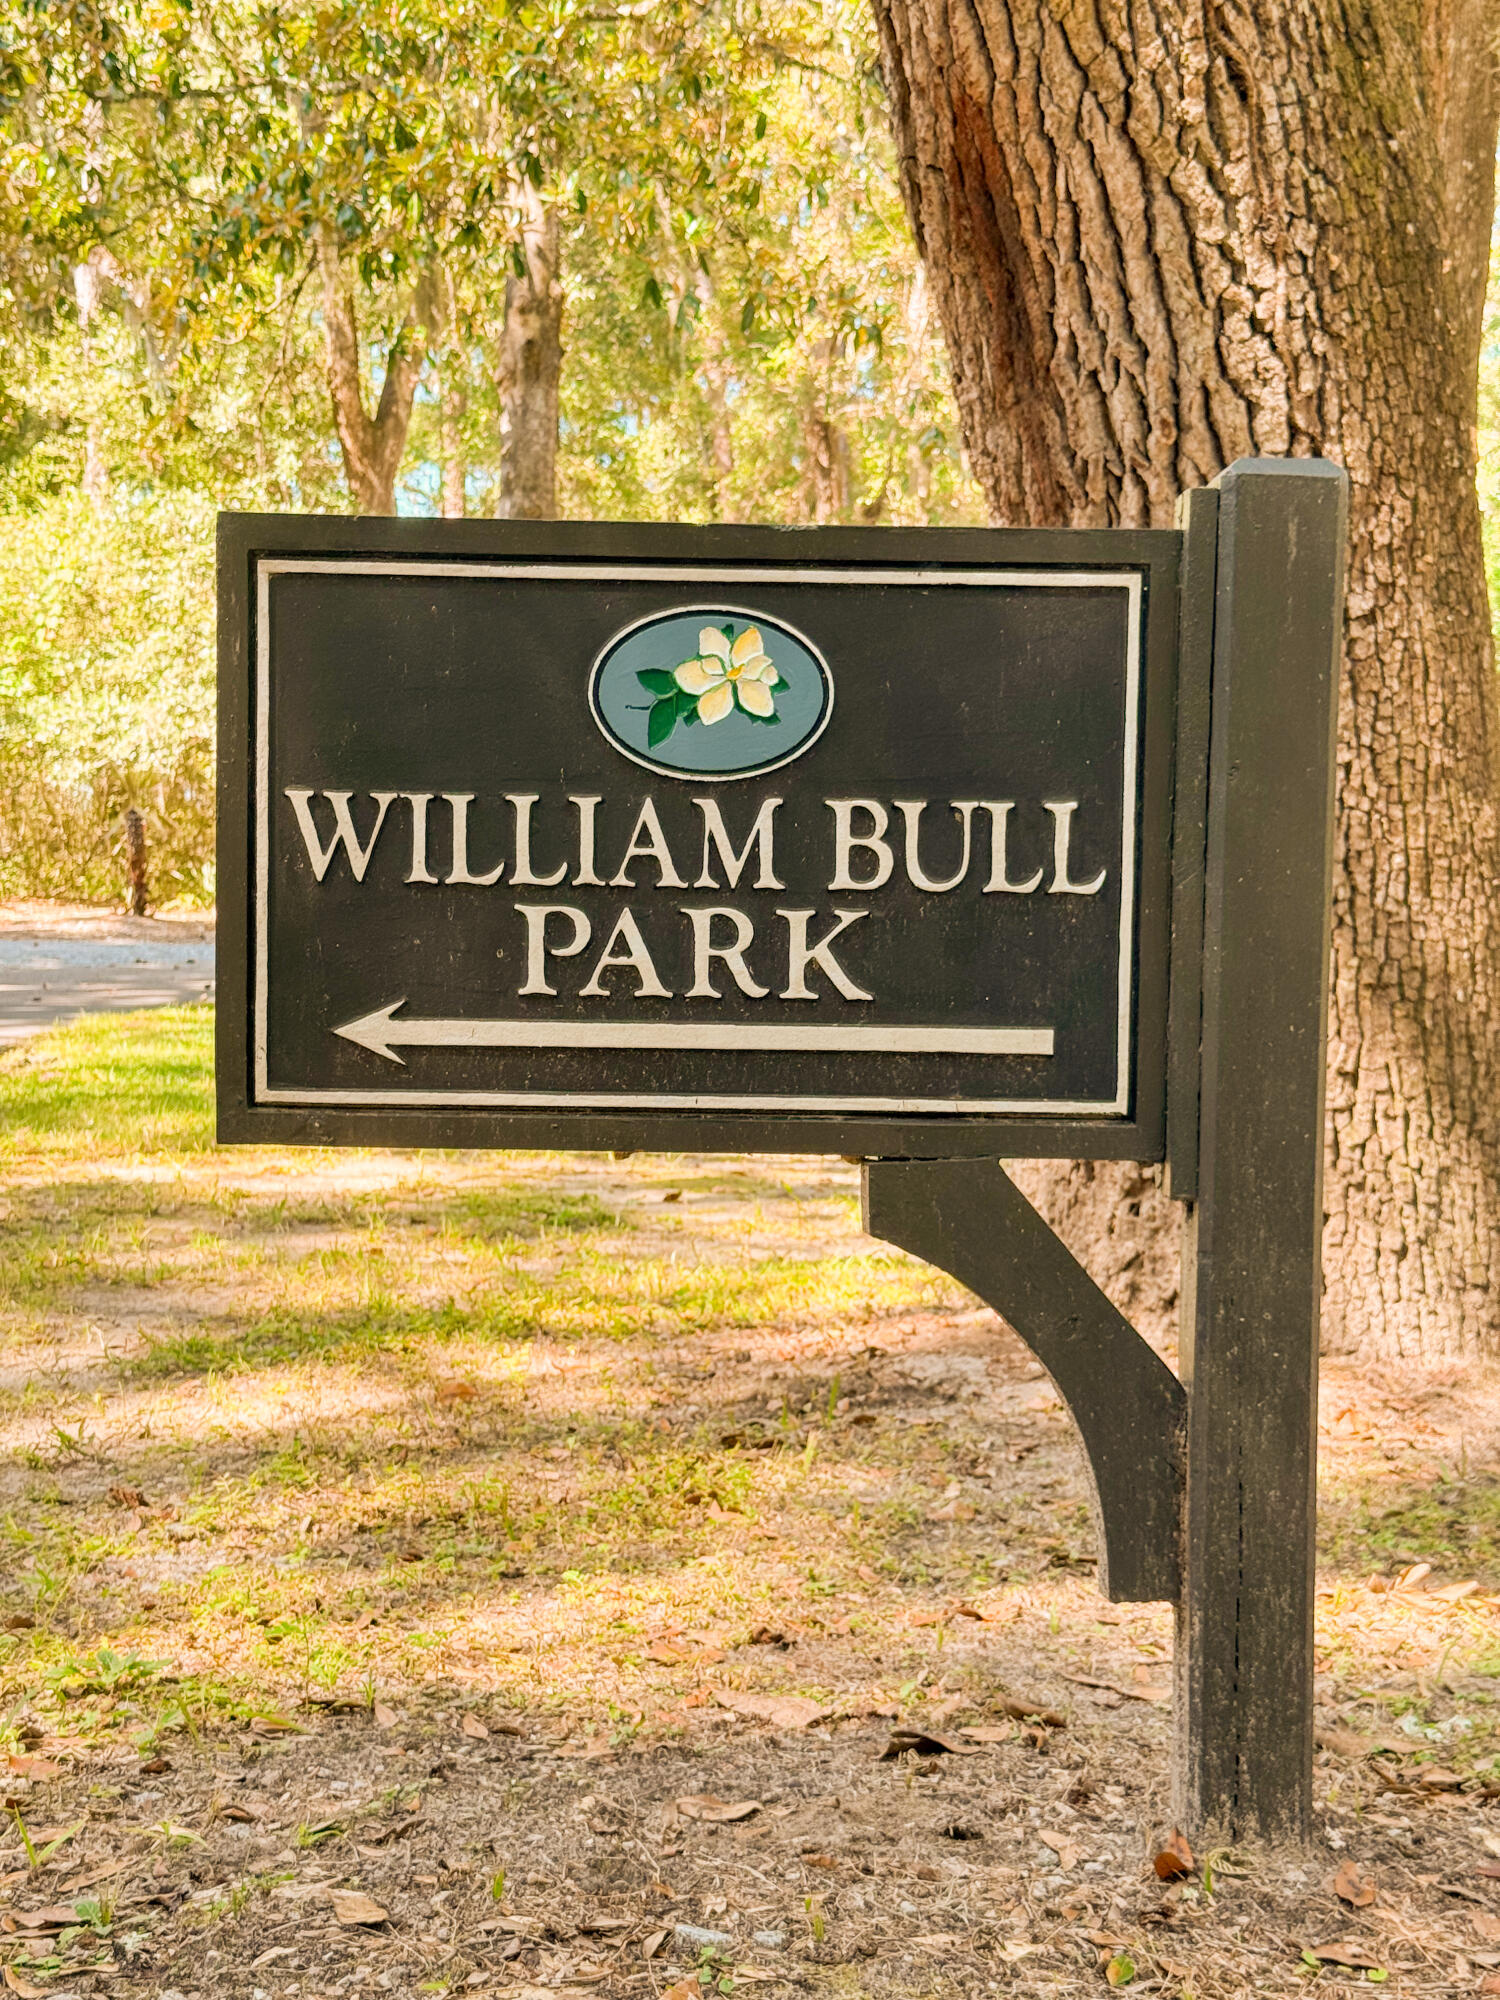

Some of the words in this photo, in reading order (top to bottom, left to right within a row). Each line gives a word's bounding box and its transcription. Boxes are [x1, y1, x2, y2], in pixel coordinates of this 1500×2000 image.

[283, 787, 787, 891] WILLIAM
[824, 799, 1108, 895] BULL
[513, 903, 875, 1002] PARK
